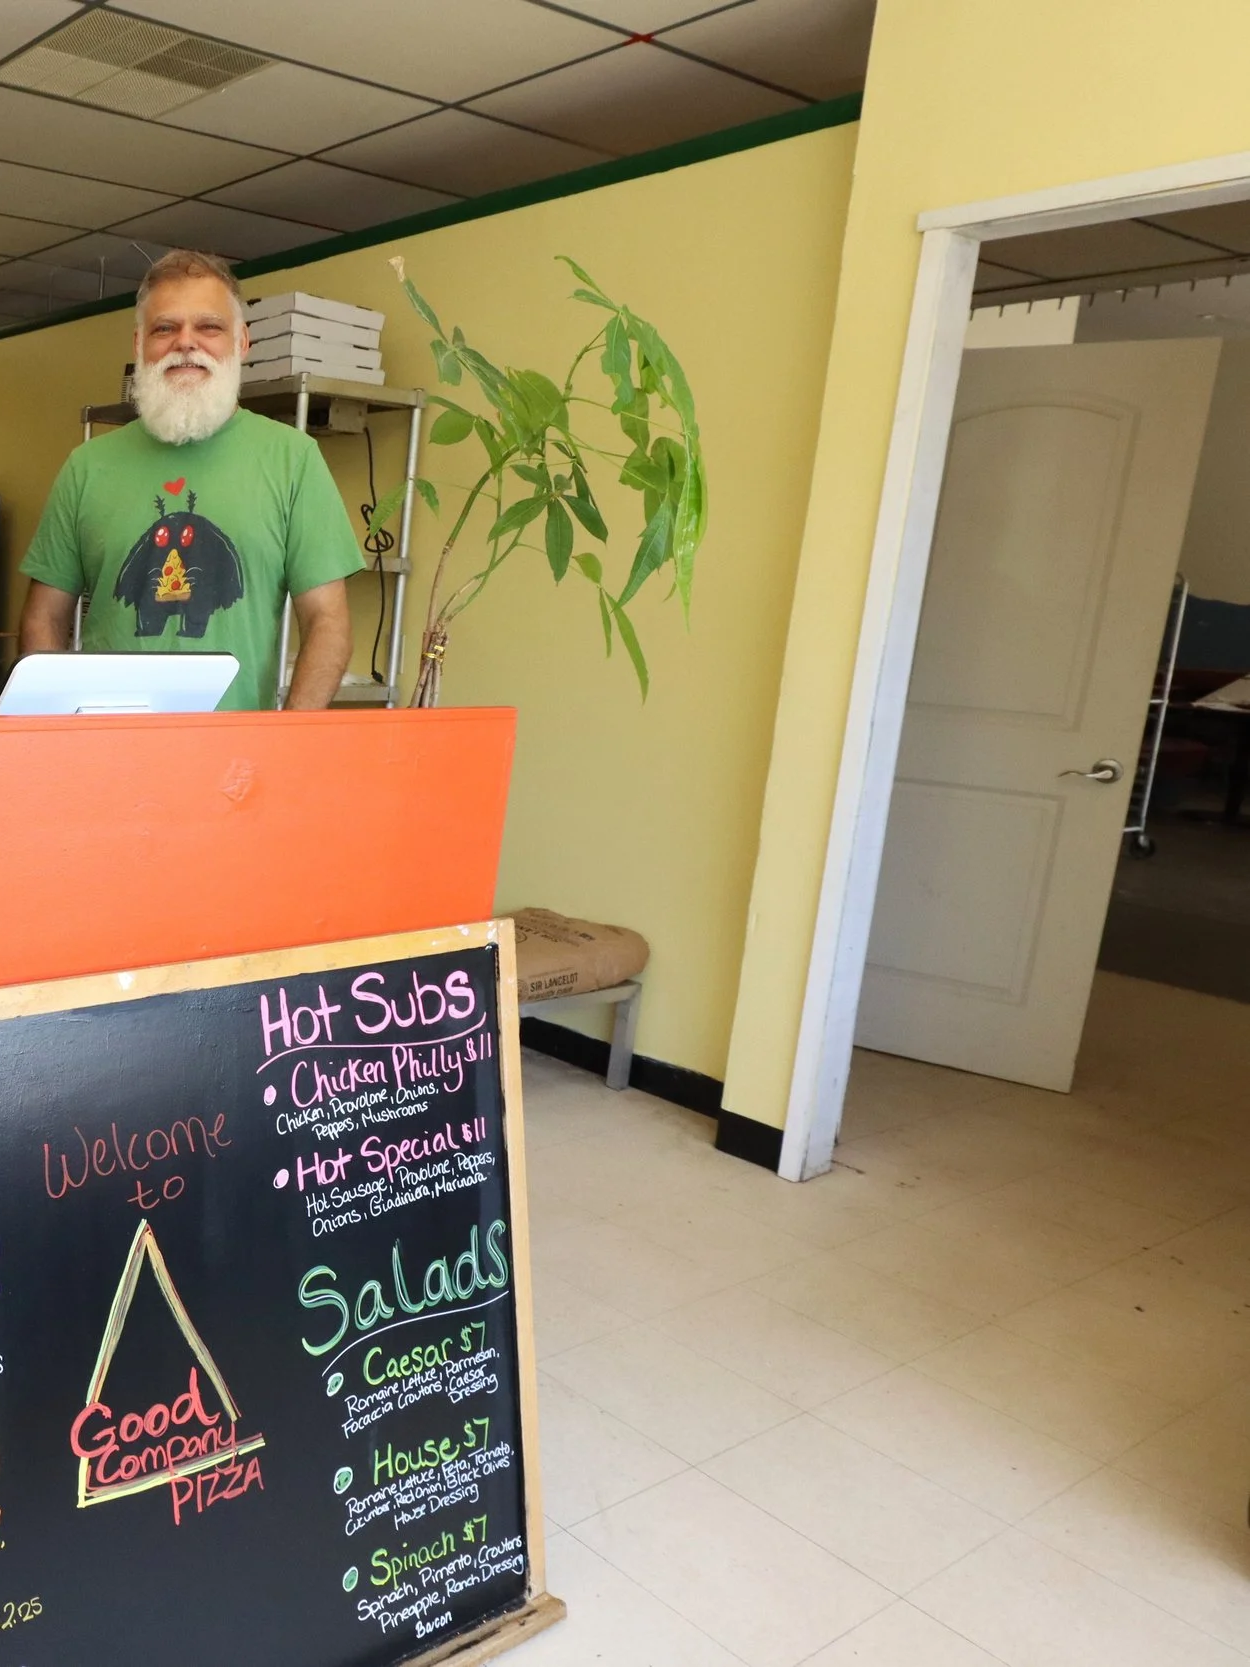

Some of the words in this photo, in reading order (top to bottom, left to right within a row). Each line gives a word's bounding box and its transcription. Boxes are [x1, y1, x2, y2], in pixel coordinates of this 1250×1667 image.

[260, 984, 342, 1056] Hot
[351, 969, 476, 1035] Subs
[530, 980, 543, 992] SIR
[544, 972, 578, 990] LANCELOT
[291, 1058, 388, 1108] Chicken
[392, 1044, 464, 1093] Philly
[464, 1032, 492, 1062] $11
[276, 1106, 331, 1135] Chicken,
[329, 1088, 394, 1119] Provolone,
[395, 1082, 439, 1105] Onions,
[311, 1117, 359, 1141] Peppers,
[361, 1101, 429, 1128] Mushrooms
[43, 1113, 233, 1199] Welcome
[296, 1147, 353, 1192] Hot
[360, 1122, 460, 1183] Special
[461, 1116, 486, 1143] $11
[305, 1190, 332, 1217] Hot
[330, 1177, 393, 1210] Sausage,
[395, 1158, 455, 1189] Provolone,
[453, 1151, 496, 1175] Peppers,
[127, 1175, 185, 1210] to
[312, 1209, 368, 1237] Onions,
[434, 1171, 488, 1198] Marinara
[298, 1218, 509, 1357] Salads
[363, 1338, 453, 1386] Caesar
[460, 1321, 486, 1353] $7
[70, 1367, 220, 1459] Good
[341, 1400, 394, 1439] Focaccia
[397, 1380, 448, 1410] Croutons,
[449, 1364, 488, 1391] Caesar
[344, 1383, 399, 1418] Romaine
[402, 1365, 443, 1392] Lettuce,
[447, 1372, 499, 1404] Dressing
[95, 1420, 237, 1484] Company
[345, 1483, 398, 1518] Romaine
[398, 1469, 441, 1494] Lettuce,
[442, 1458, 471, 1482] Feta,
[468, 1440, 515, 1466] Tomato,
[372, 1436, 461, 1486] House
[463, 1416, 490, 1450] $7
[394, 1491, 416, 1507] Red
[415, 1481, 446, 1502] Onion,
[446, 1468, 480, 1490] Black
[483, 1455, 510, 1476] Olives
[170, 1457, 265, 1527] PIZZA
[394, 1504, 427, 1531] House
[429, 1484, 479, 1512] Dressing
[357, 1582, 419, 1621] Spinach,
[418, 1553, 477, 1587] Pimento,
[478, 1535, 523, 1565] Croutons
[370, 1531, 456, 1591] Spinach
[462, 1514, 488, 1543] $7
[378, 1591, 446, 1634] Pineapple,
[445, 1573, 481, 1598] Ranch
[479, 1553, 525, 1582] Dressing
[415, 1610, 453, 1639] Bacon
